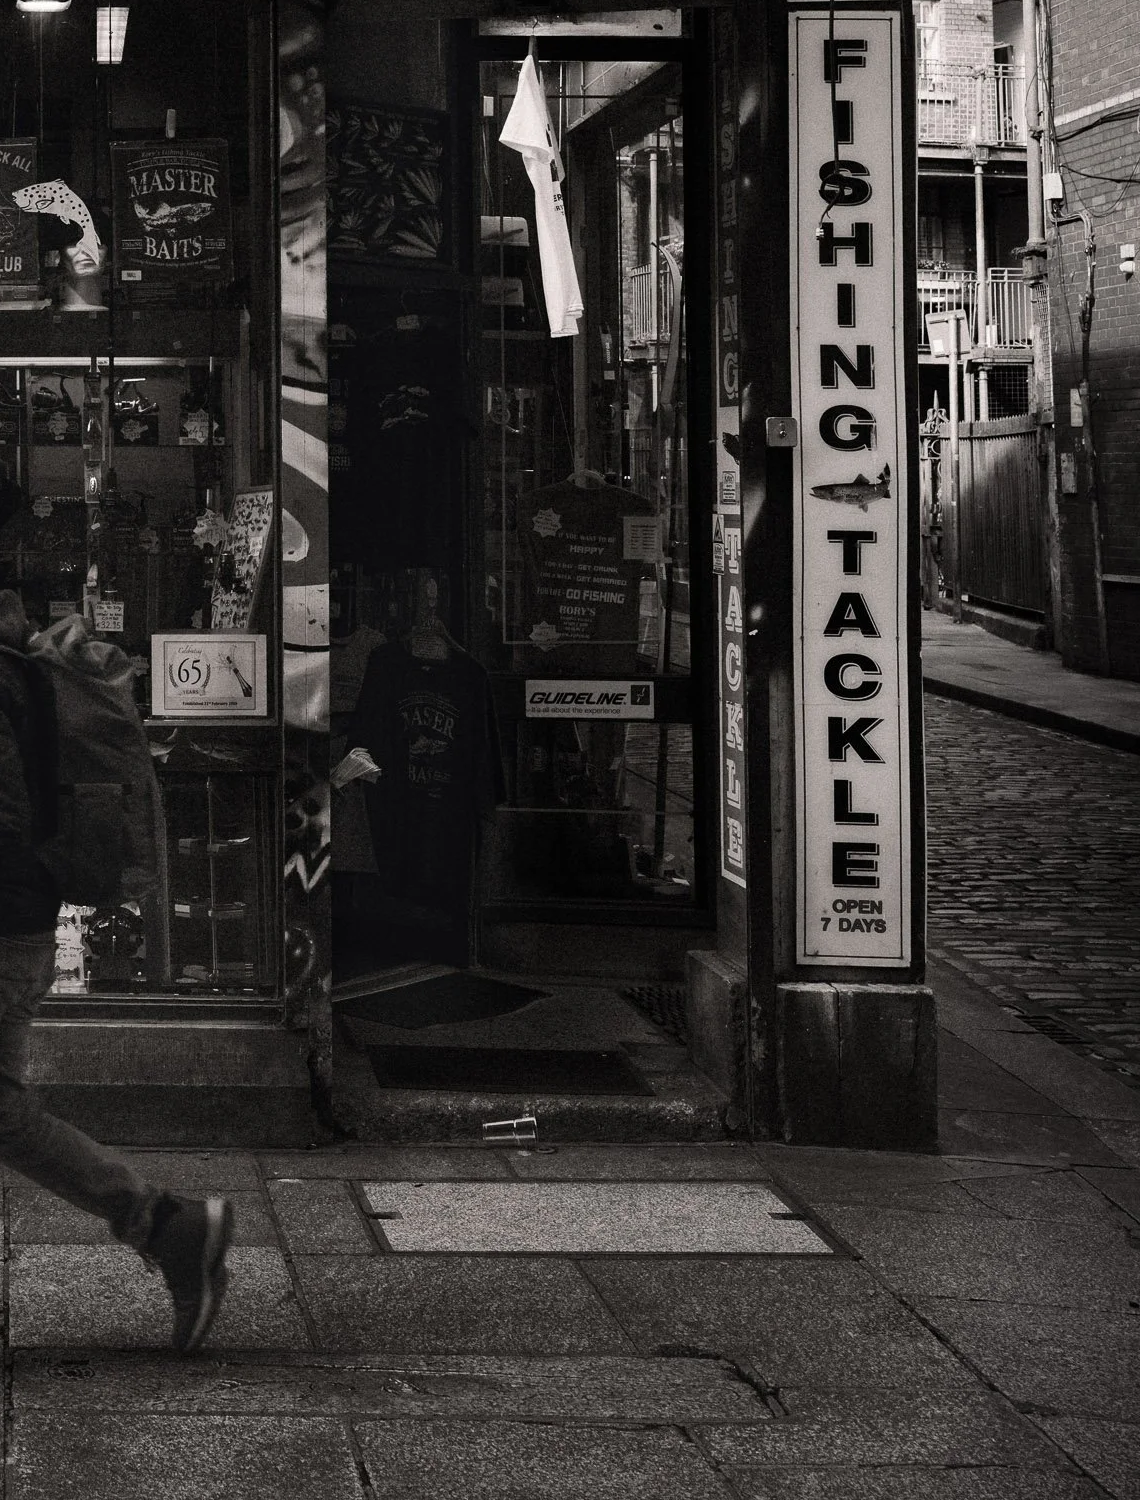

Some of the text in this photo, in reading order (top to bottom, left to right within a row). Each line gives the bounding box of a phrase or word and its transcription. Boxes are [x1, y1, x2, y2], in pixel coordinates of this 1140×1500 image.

[11, 155, 32, 173] ALL
[128, 168, 219, 200] MASTER
[817, 38, 878, 452] FISHING
[569, 544, 605, 556] HAPPY
[593, 565, 619, 574] DRUNK
[592, 577, 627, 586] MARRIED
[566, 588, 580, 600] GO
[583, 589, 626, 605] FISHING
[559, 604, 597, 617] RORY'S
[178, 657, 202, 685] 65
[529, 692, 625, 705] GUIDELINE
[723, 527, 746, 867] TACKLE
[821, 530, 886, 890] TACKLE
[831, 898, 884, 916] OPEN
[820, 916, 888, 934] 7 DAYS
